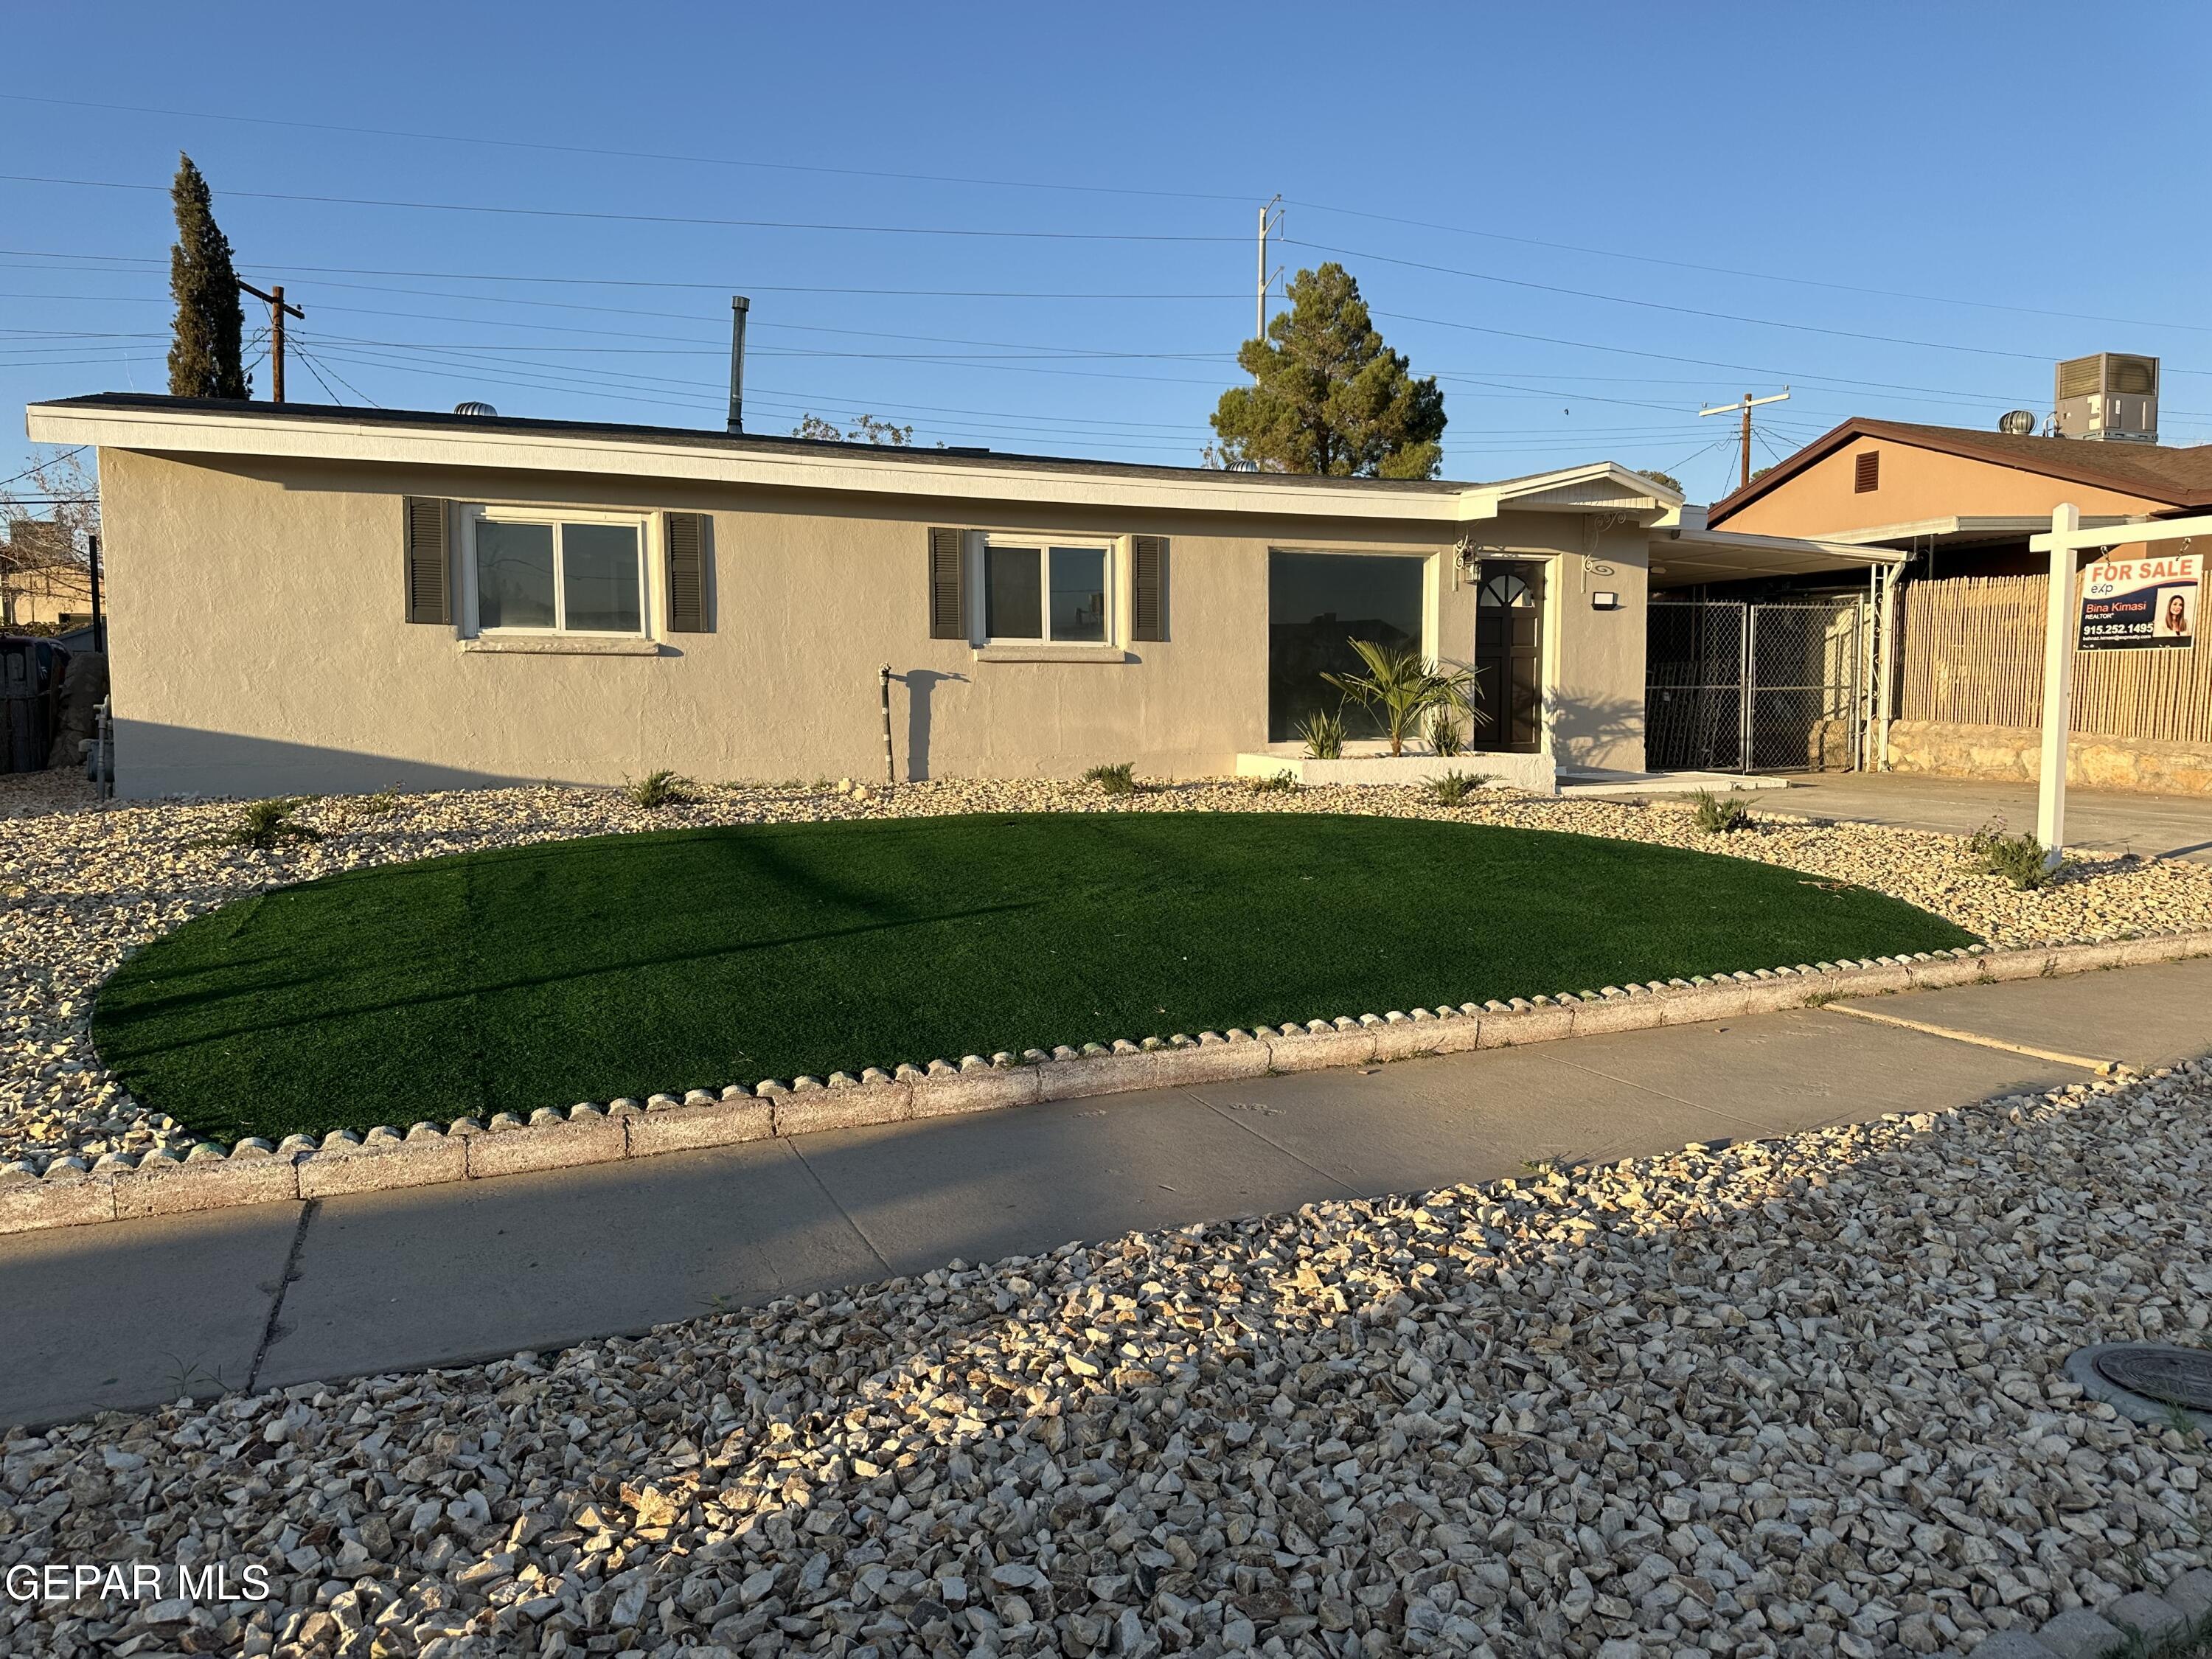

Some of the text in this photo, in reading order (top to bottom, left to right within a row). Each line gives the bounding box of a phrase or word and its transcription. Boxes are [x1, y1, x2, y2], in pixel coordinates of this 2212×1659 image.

[2092, 559, 2193, 582] FOR SALE
[2086, 601, 2147, 613] Bina Kimasi
[2083, 623, 2154, 635] 915.252.1495
